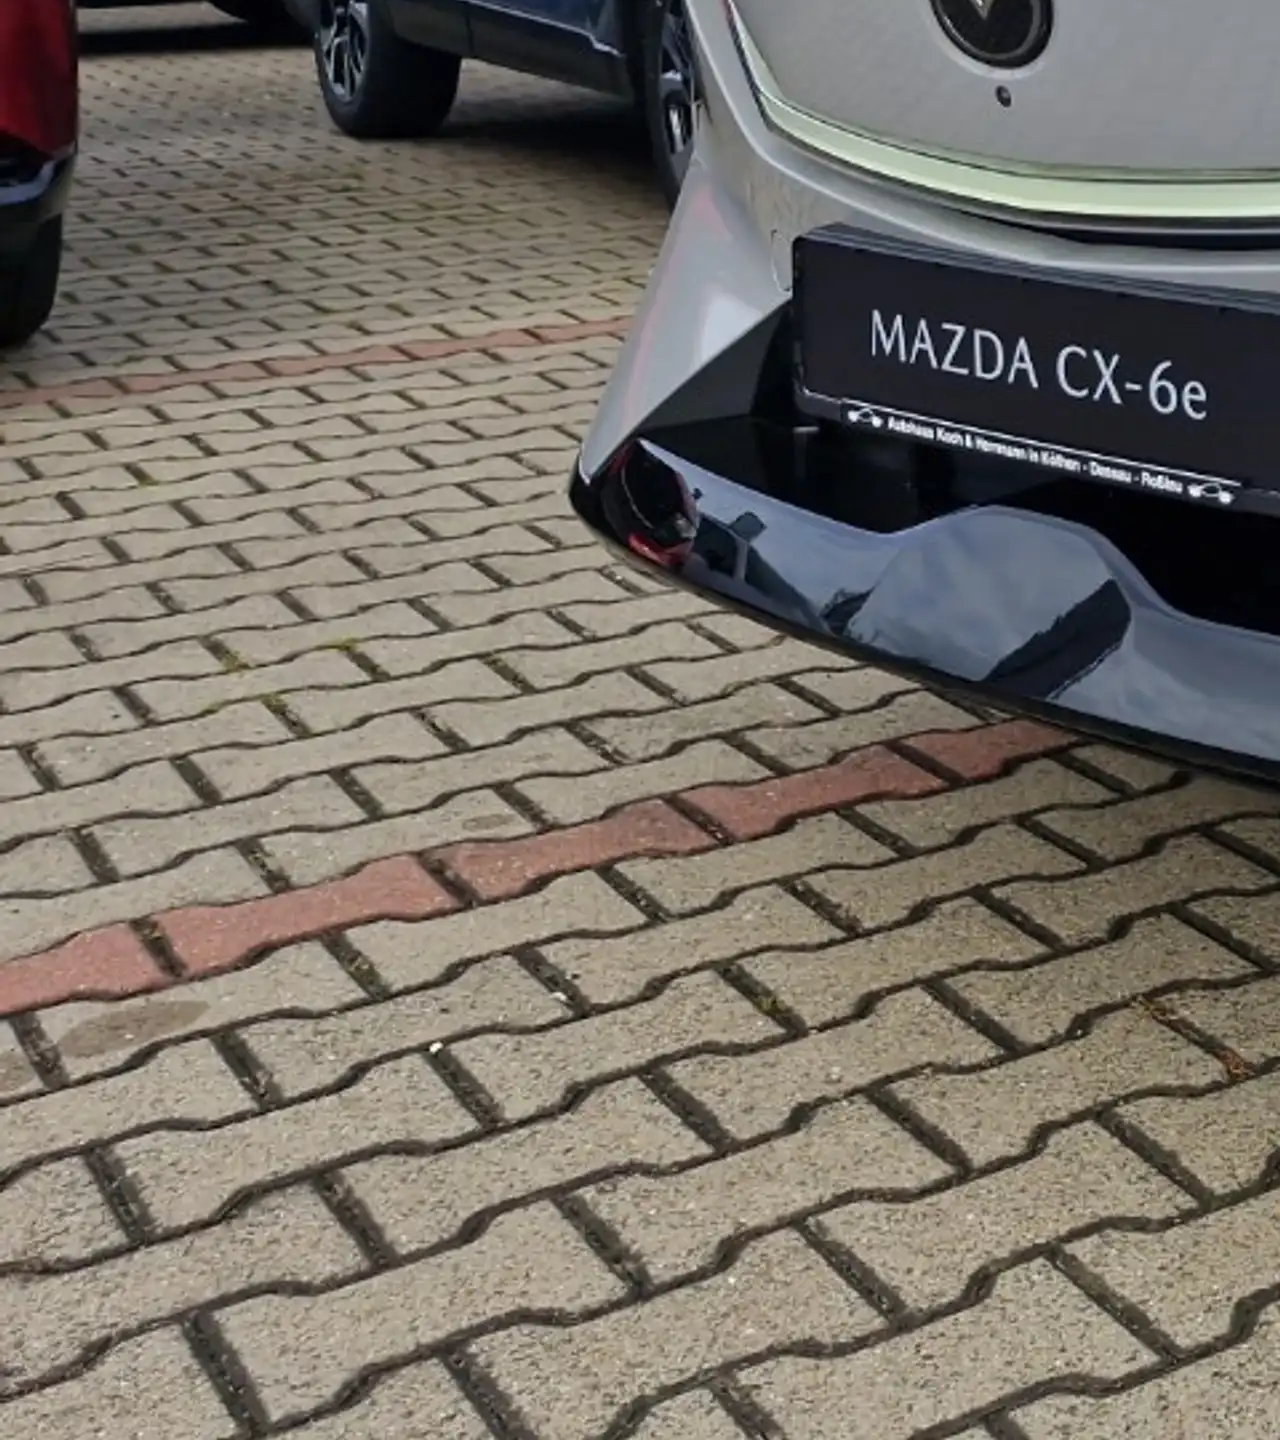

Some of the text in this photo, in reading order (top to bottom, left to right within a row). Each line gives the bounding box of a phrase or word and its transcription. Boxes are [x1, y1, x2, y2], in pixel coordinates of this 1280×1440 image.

[871, 309, 1208, 420] MAZDA CX-6e
[937, 426, 964, 448] Koch
[975, 436, 1027, 461] Herrmann
[1089, 461, 1132, 484] Dessau
